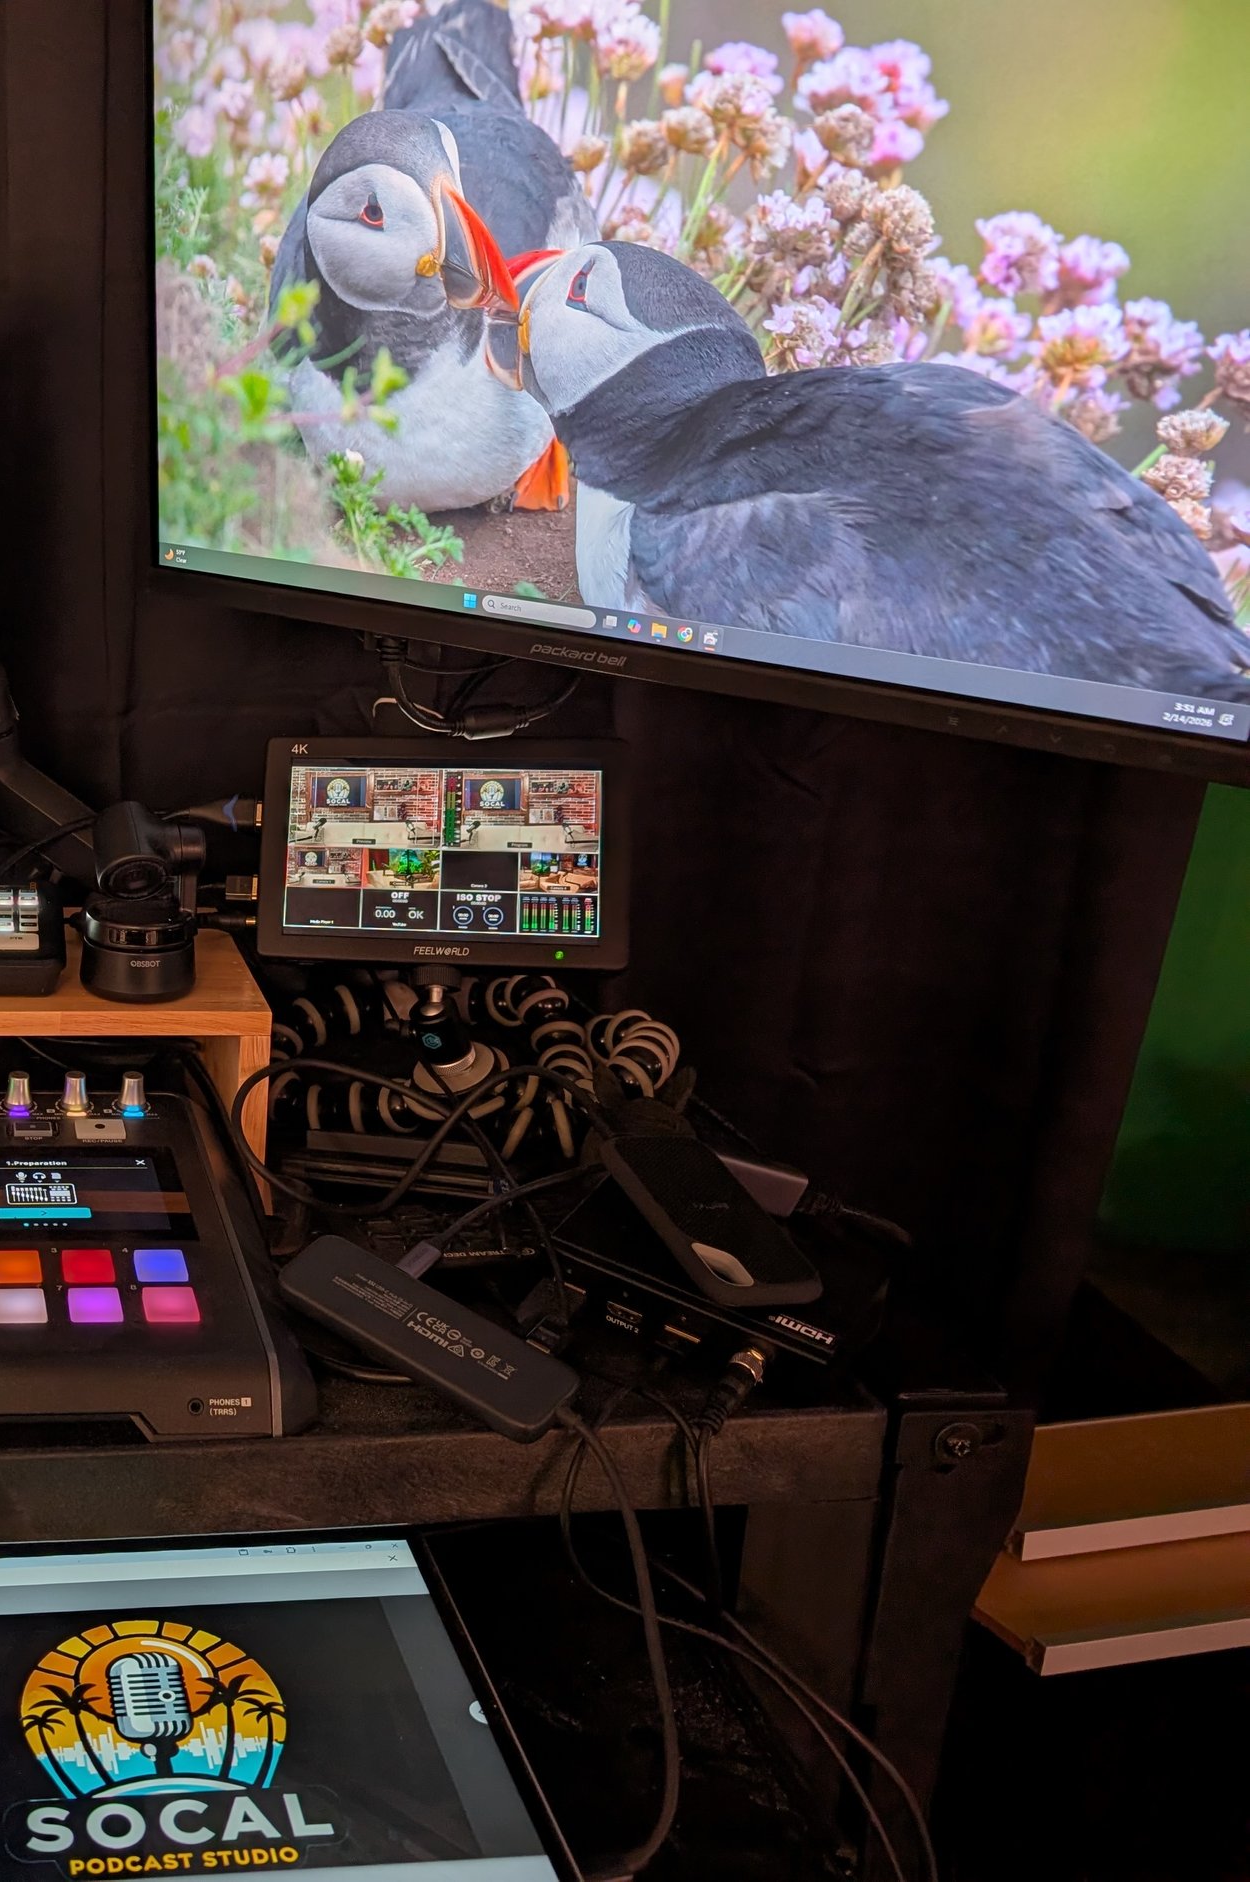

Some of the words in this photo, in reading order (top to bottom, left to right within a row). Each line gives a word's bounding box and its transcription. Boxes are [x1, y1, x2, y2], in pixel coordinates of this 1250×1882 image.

[500, 602, 522, 612] Search
[530, 643, 597, 661] packard
[597, 653, 627, 667] bell
[1196, 706, 1216, 716] AM
[291, 743, 309, 754] 4K
[391, 891, 409, 899] OFF
[475, 894, 502, 902] STOP
[375, 909, 396, 918] 0.00
[408, 910, 424, 920] OK
[130, 960, 161, 968] OBSBOT
[5, 1159, 68, 1167] 1.Preparation
[605, 1314, 632, 1332] OUTPUT
[406, 1320, 450, 1348] HDMI
[773, 1315, 834, 1345] HDMI
[209, 1398, 240, 1406] PHONES
[209, 1407, 237, 1416] (TRRS)
[26, 1793, 335, 1853] SOCAL
[69, 1852, 193, 1876] PODCAST
[203, 1846, 299, 1868] STUDIO
